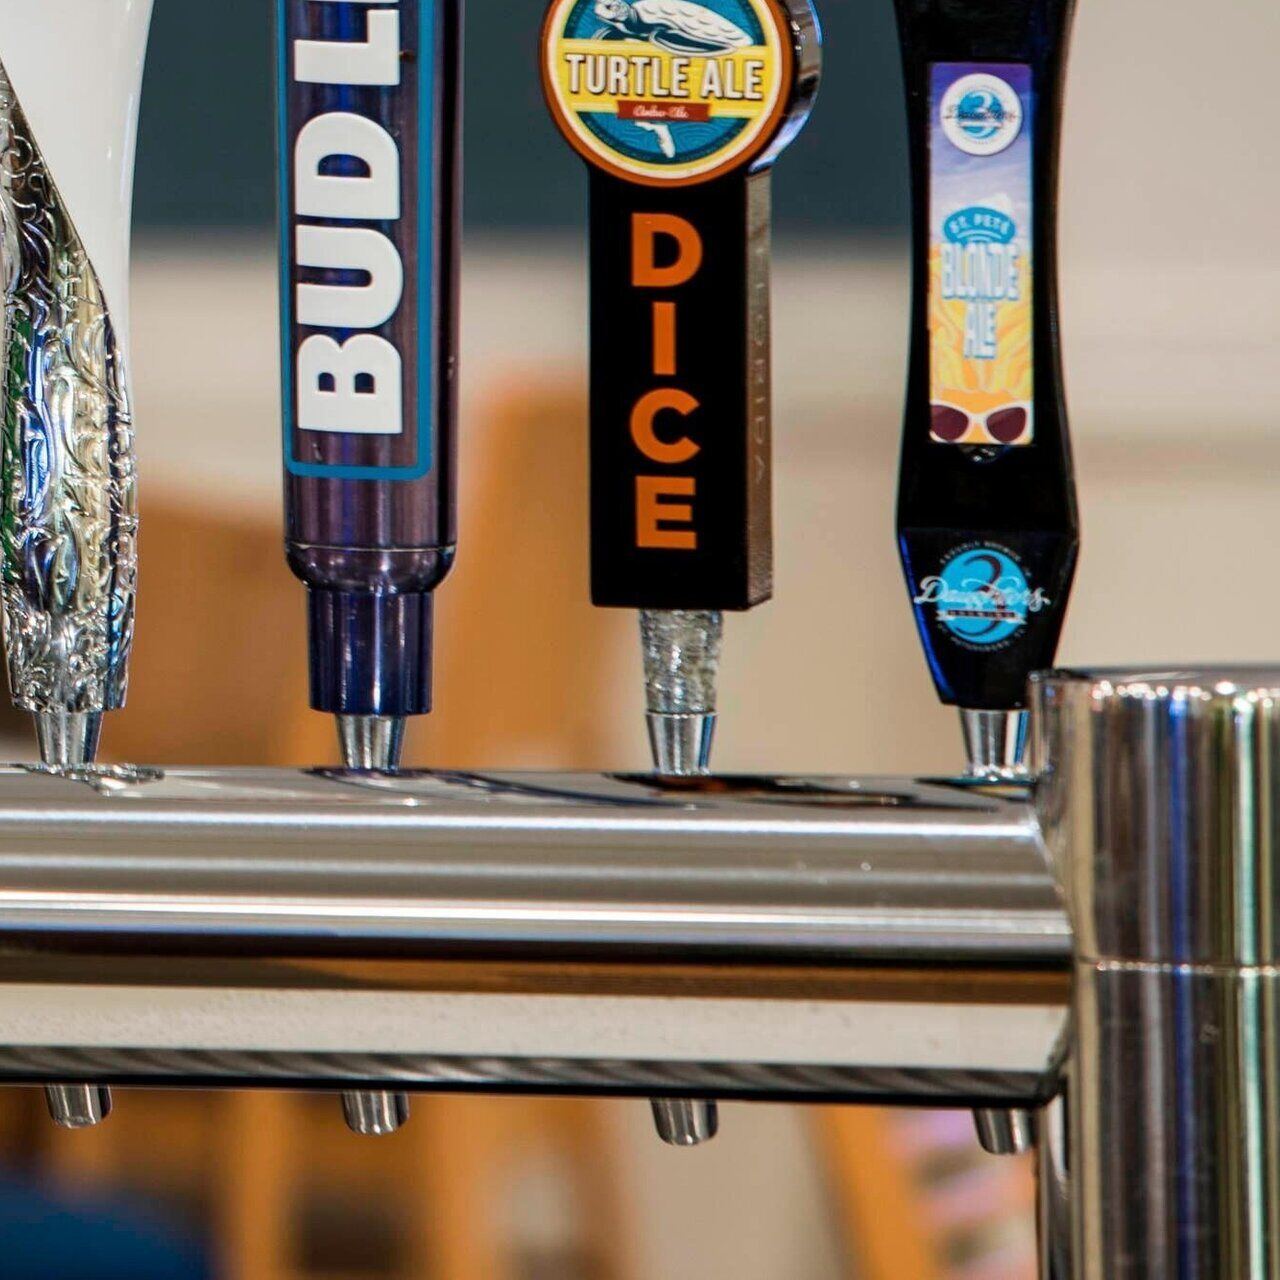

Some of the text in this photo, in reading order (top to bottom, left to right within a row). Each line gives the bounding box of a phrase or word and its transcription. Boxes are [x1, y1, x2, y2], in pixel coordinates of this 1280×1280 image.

[565, 53, 765, 100] TURTLE ALE
[295, 111, 404, 435] BUD
[629, 212, 704, 550] DICE
